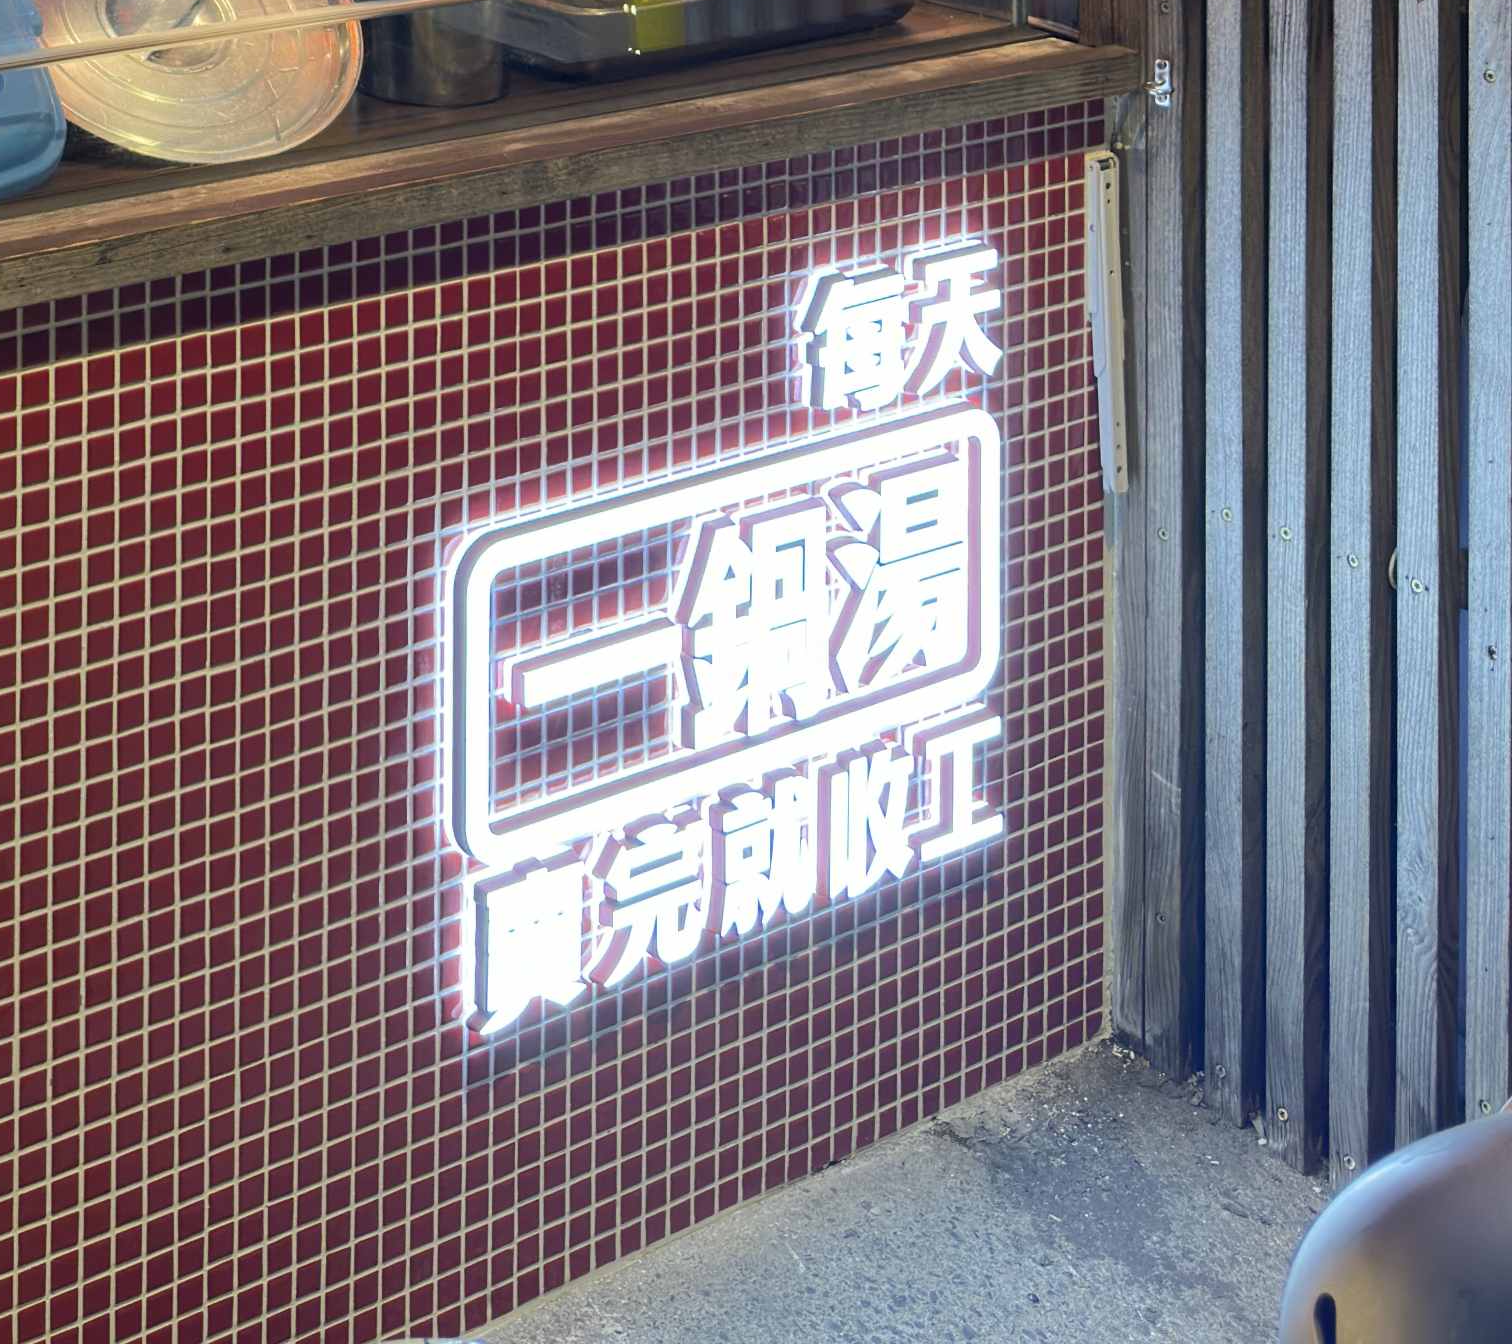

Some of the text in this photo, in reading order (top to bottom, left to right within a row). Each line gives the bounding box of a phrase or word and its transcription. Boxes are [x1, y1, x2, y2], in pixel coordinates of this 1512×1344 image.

[794, 239, 1005, 412] 每天
[501, 450, 965, 749] 一鍋湯
[462, 704, 1006, 1036] 賣完就收工
